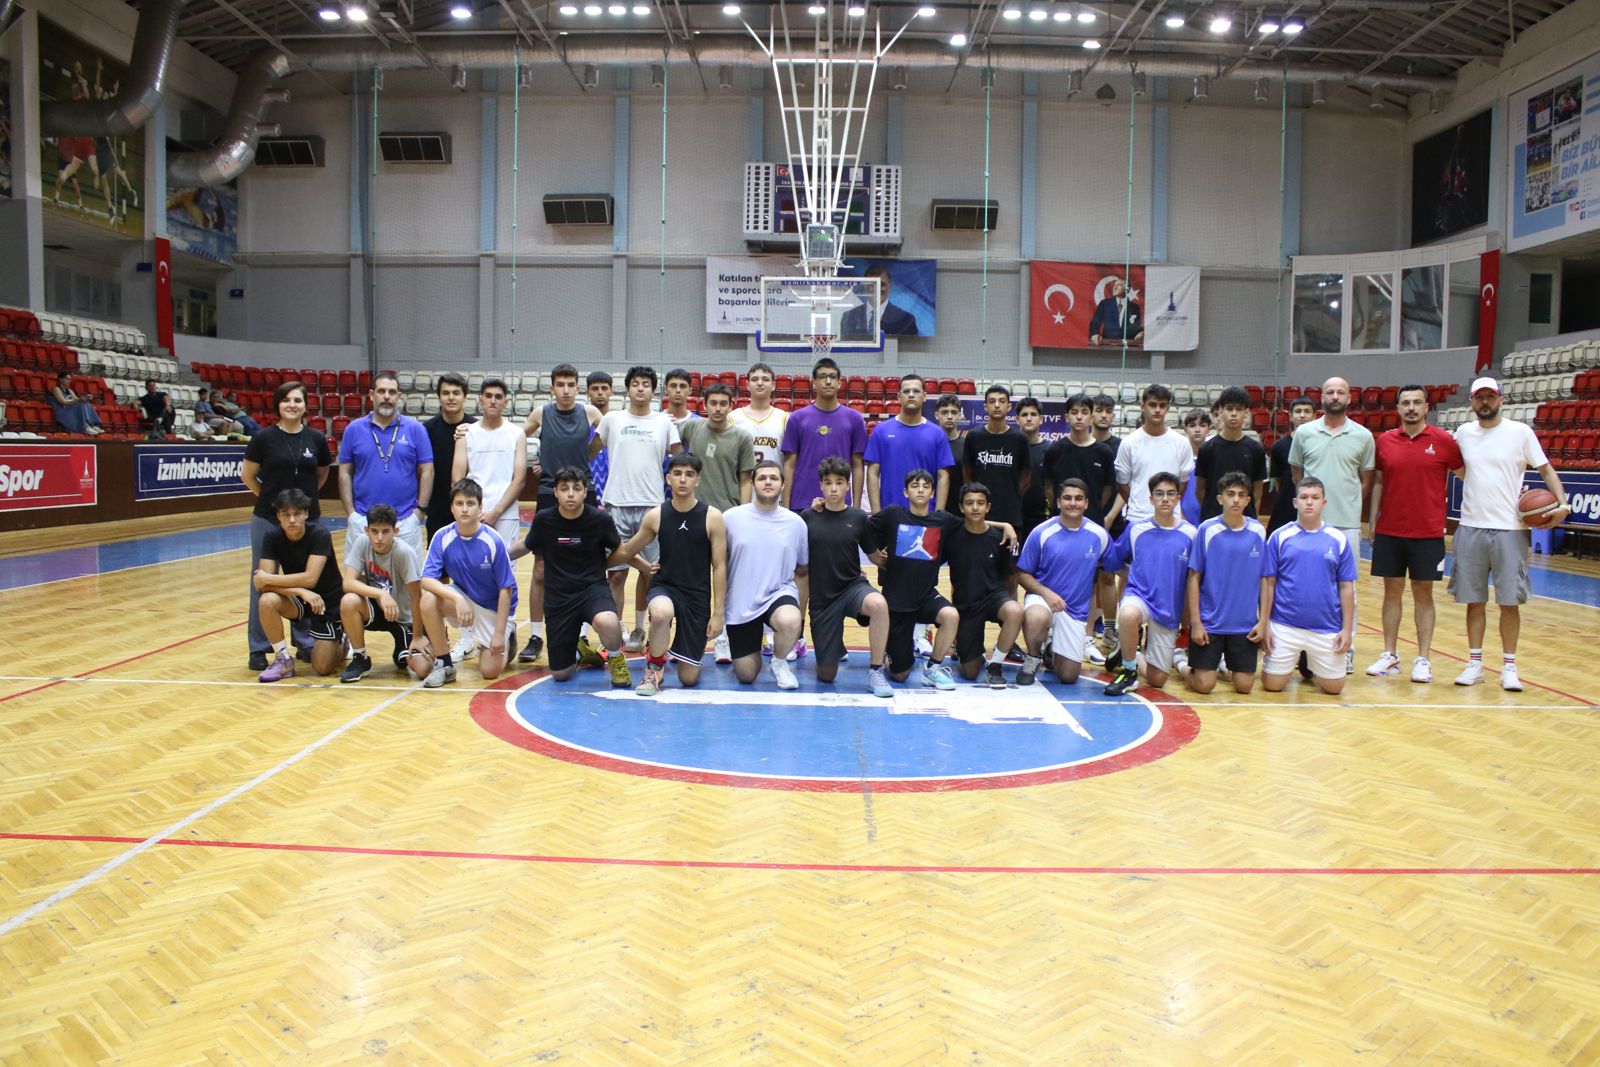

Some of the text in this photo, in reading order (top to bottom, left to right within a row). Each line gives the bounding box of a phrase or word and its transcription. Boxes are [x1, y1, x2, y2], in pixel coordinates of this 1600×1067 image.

[1562, 144, 1580, 163] BİZ
[1561, 153, 1600, 180] BİR AİL
[719, 274, 752, 283] Katılan
[731, 287, 782, 296] sporcuara
[753, 436, 778, 448] KERS
[157, 457, 243, 482] izmirbsbspor.o
[0, 464, 44, 497] Spor
